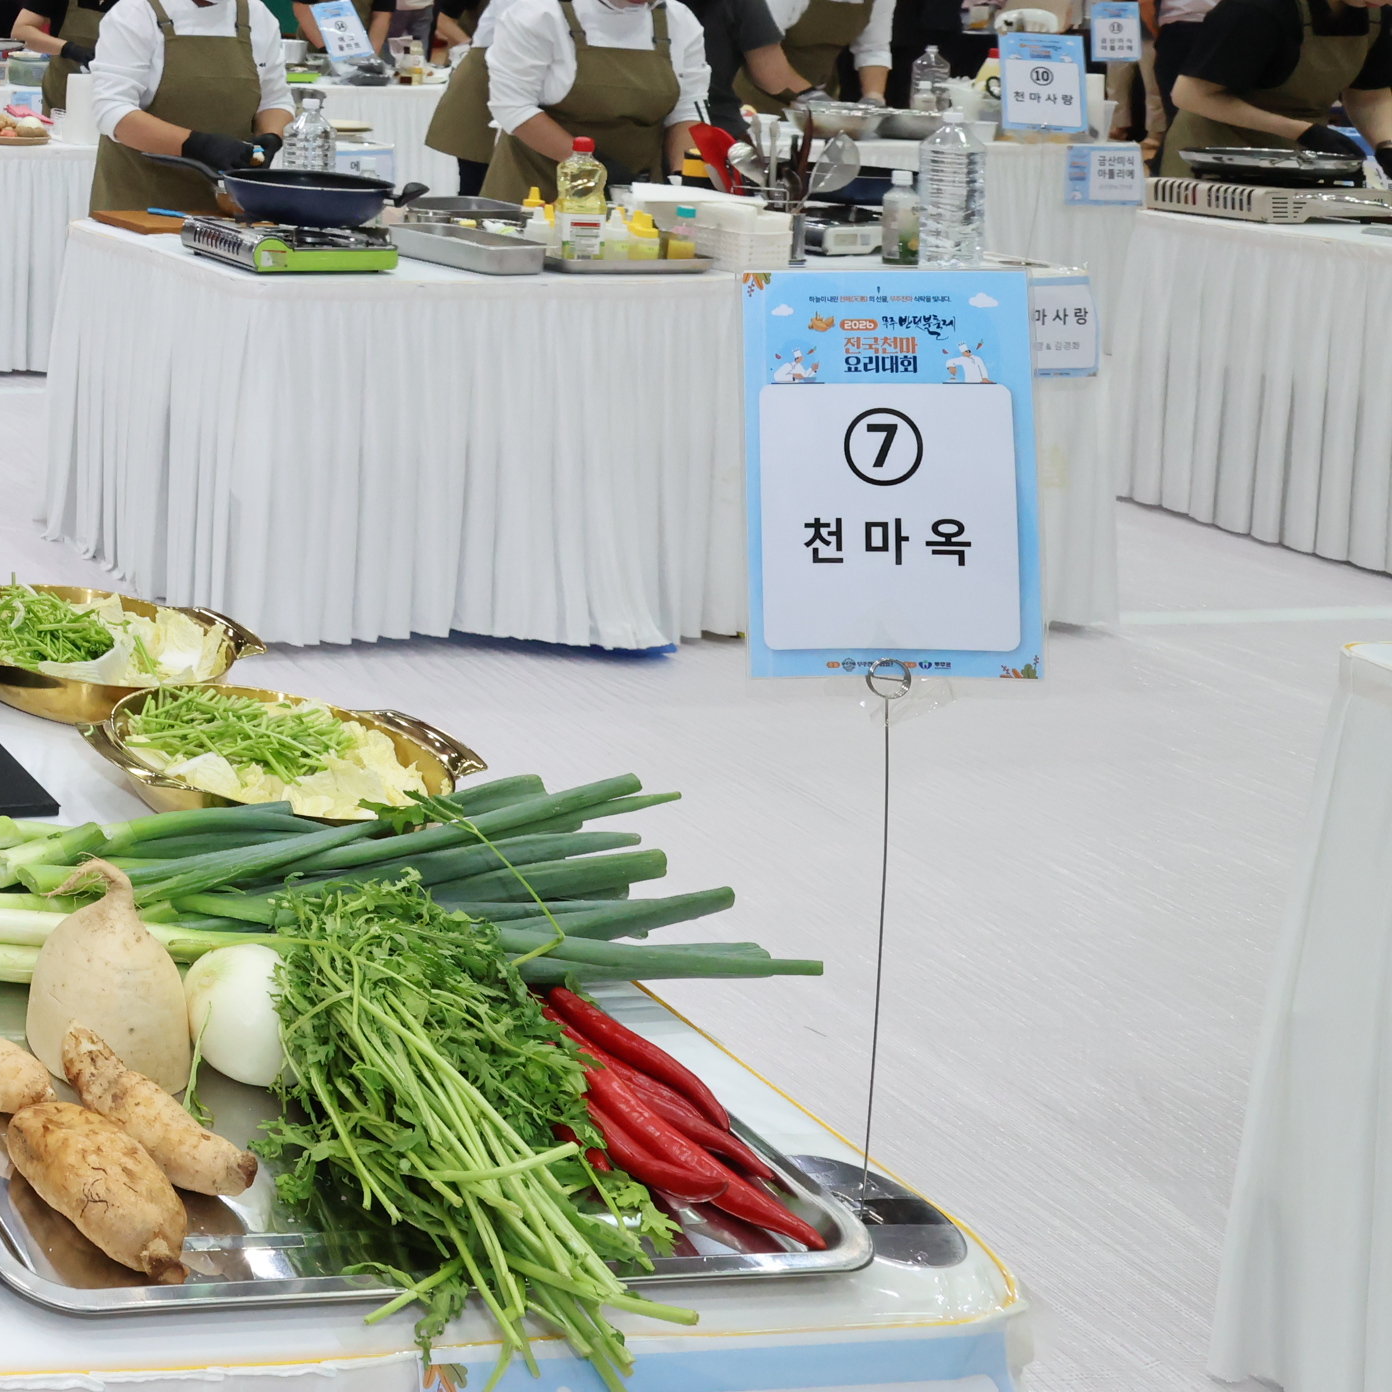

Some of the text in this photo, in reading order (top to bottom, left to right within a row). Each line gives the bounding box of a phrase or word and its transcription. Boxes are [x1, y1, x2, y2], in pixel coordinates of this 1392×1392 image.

[844, 320, 874, 330] 2026
[843, 337, 918, 355] 전국천마
[844, 356, 918, 374] 요리대회
